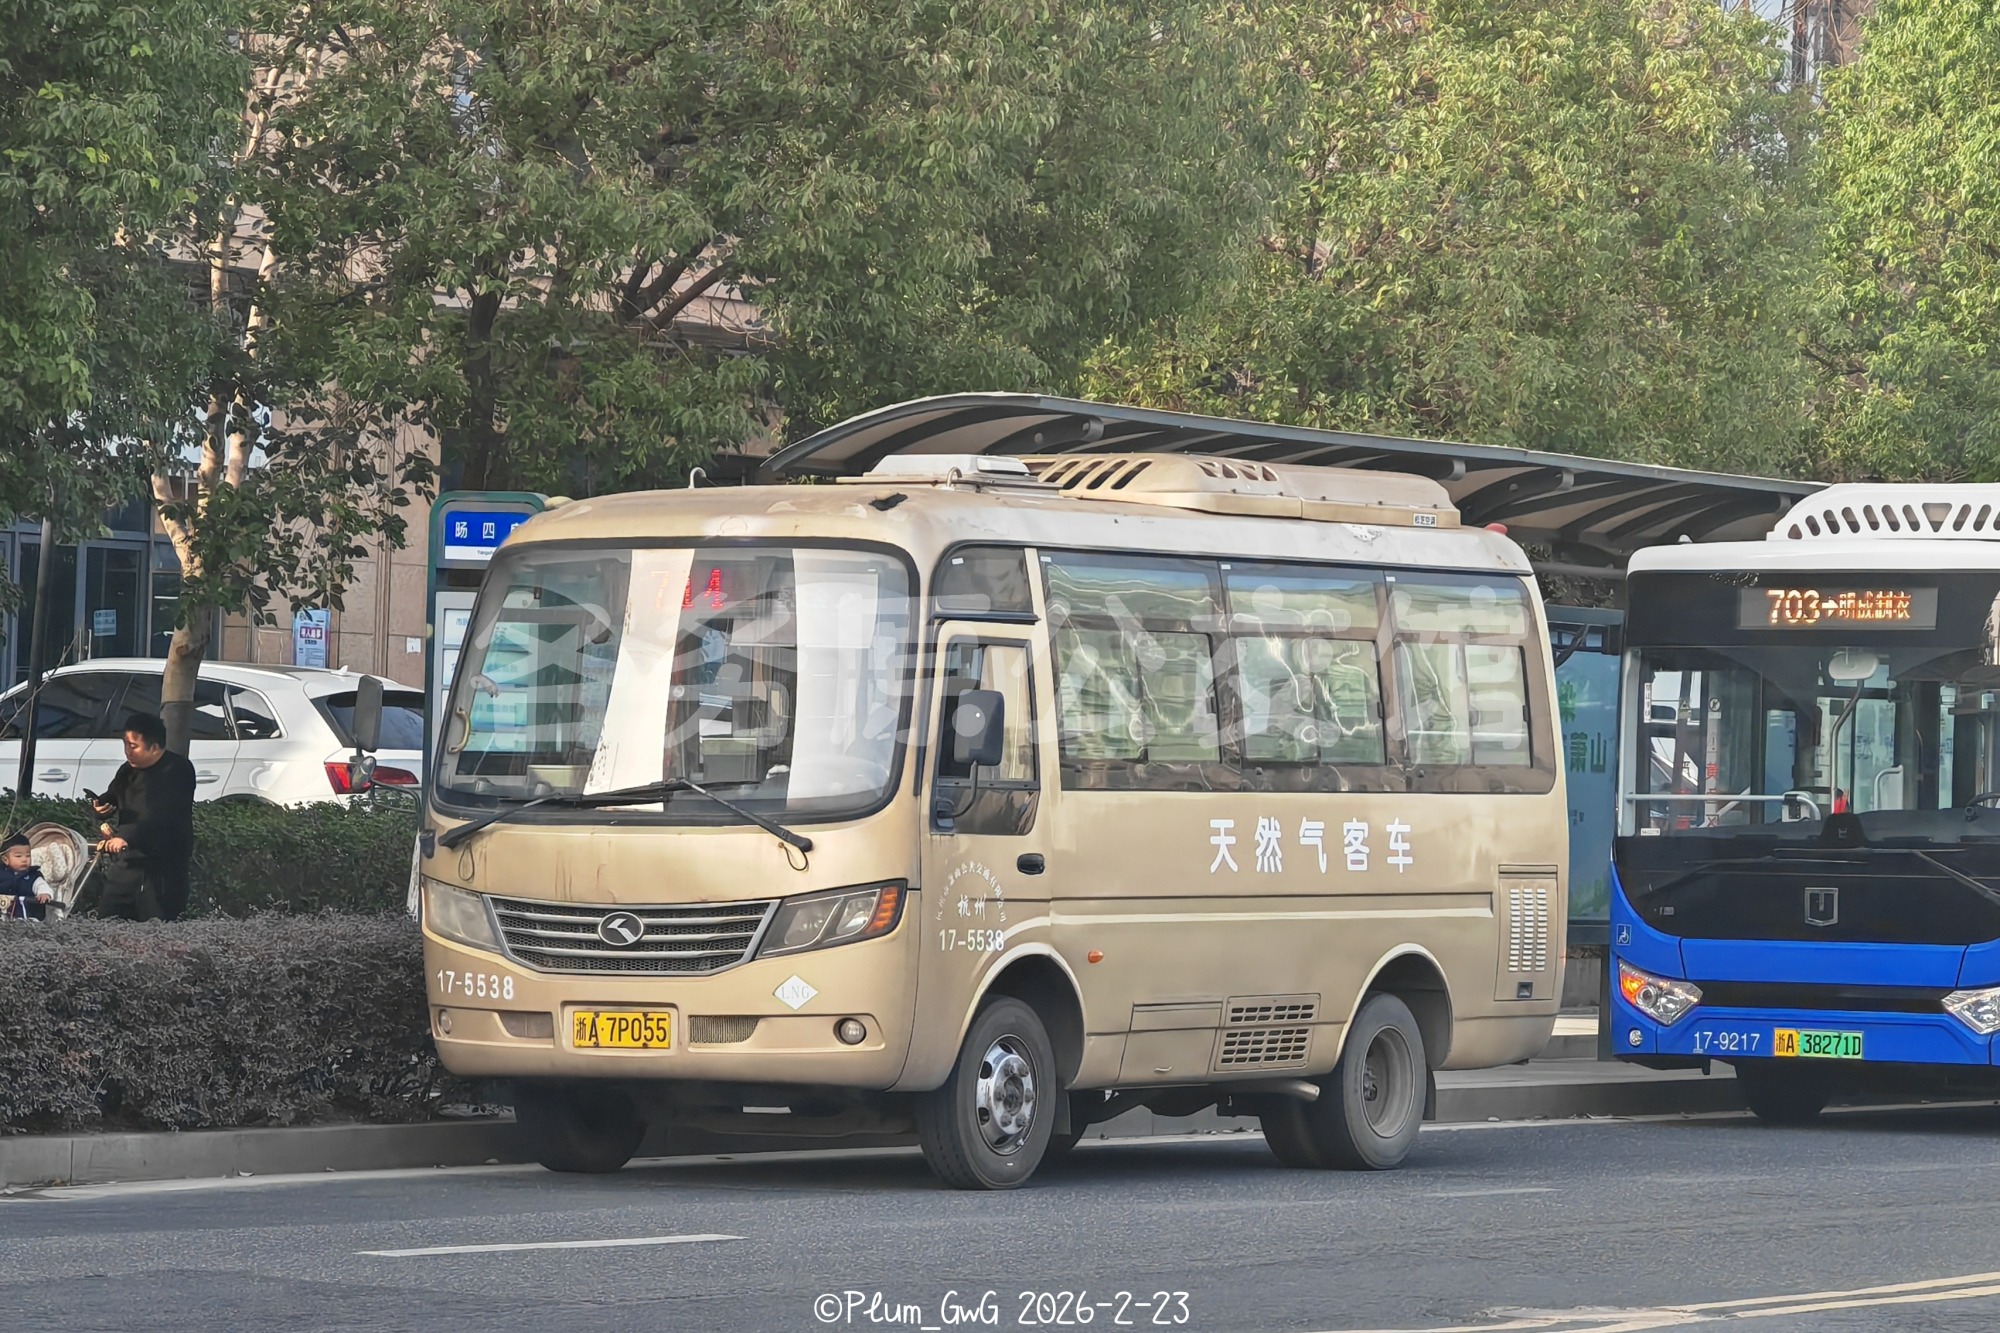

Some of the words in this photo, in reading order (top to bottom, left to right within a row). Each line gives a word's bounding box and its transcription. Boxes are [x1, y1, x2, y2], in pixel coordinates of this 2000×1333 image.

[455, 521, 519, 539] 旸四
[1767, 589, 1821, 624] 703
[1563, 731, 1607, 773] 萧山
[1209, 815, 1414, 874] 天然气客车
[957, 893, 986, 921] 杭州
[939, 929, 1005, 952] 17-5538
[437, 968, 514, 1000] 17-5538
[781, 985, 810, 1000] LNG
[1693, 1030, 1761, 1052] 17-9217
